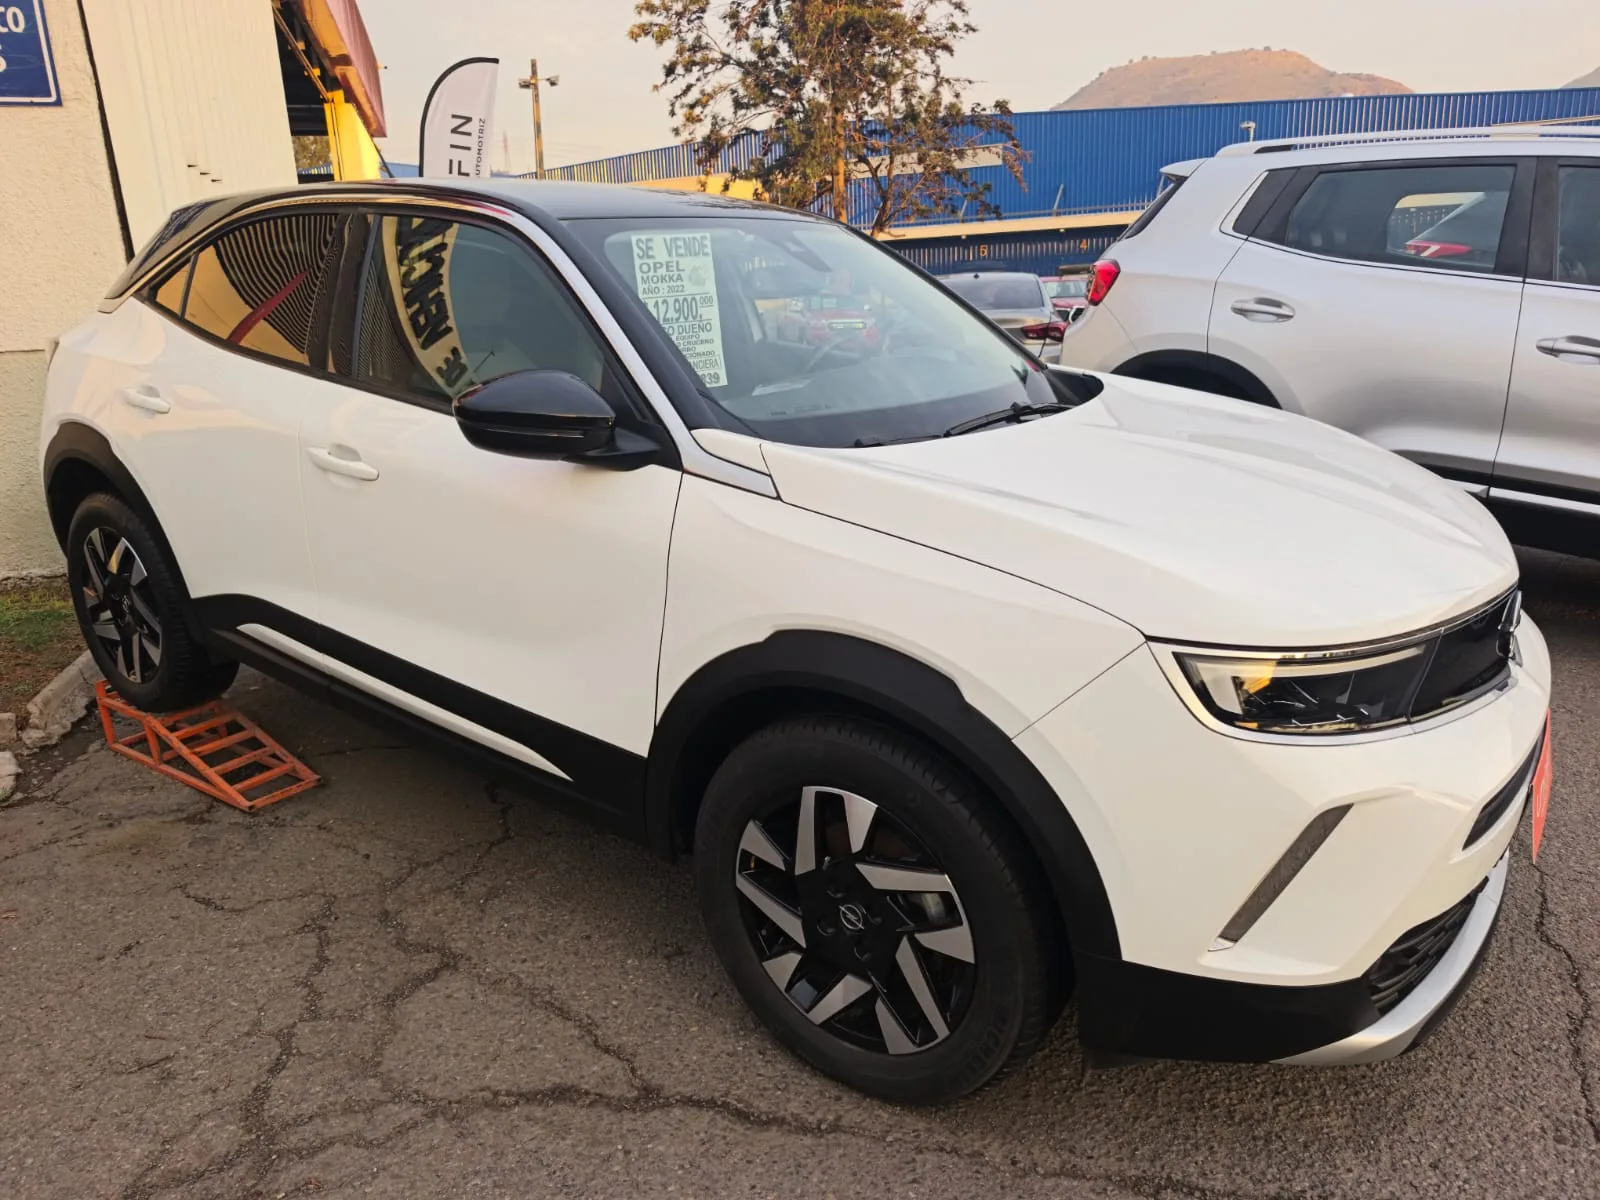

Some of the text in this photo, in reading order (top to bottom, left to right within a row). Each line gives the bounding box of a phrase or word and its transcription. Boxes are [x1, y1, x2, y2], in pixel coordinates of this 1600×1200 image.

[475, 118, 486, 178] UTOMOTRIZ
[635, 235, 709, 260] SE VENDE
[1080, 239, 1088, 252] 4
[638, 260, 685, 273] OPEL
[640, 273, 684, 286] MOKKA
[667, 284, 685, 294] 2022
